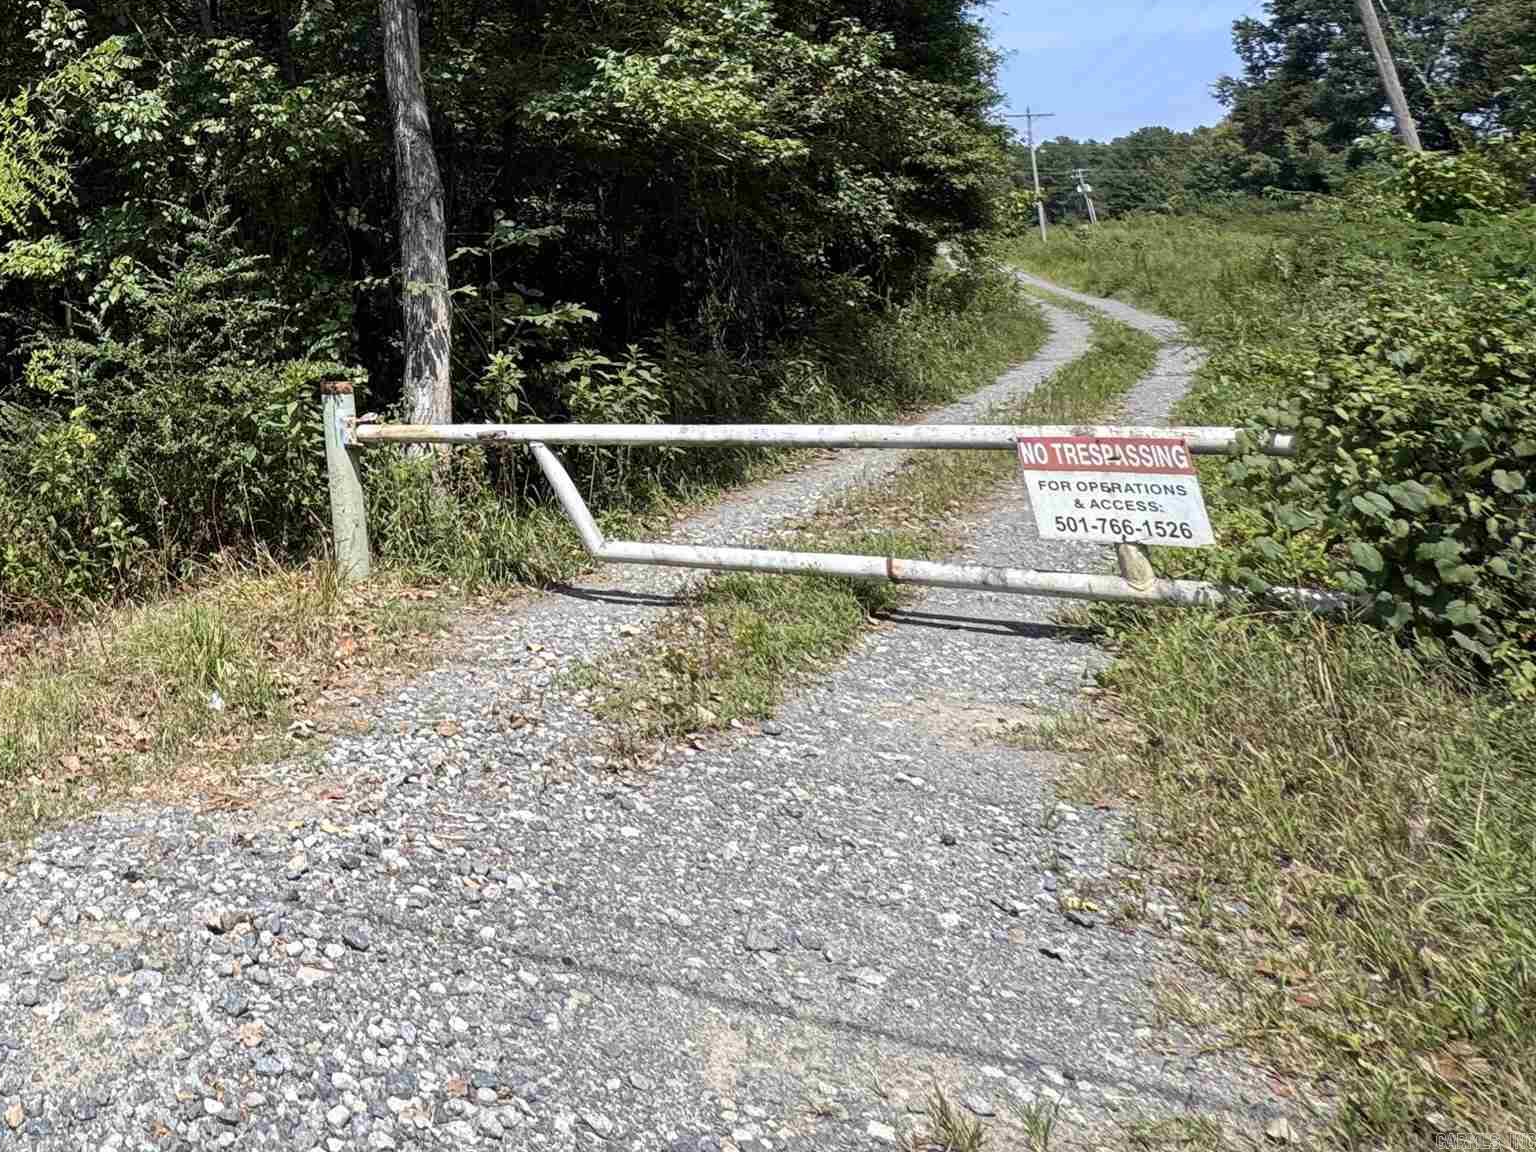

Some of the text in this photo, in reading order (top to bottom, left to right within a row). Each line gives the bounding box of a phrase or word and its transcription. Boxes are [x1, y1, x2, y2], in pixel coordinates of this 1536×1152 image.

[1019, 441, 1190, 469] NO TRESPASSING
[1038, 480, 1188, 496] FOR OPERATIONS
[1074, 499, 1165, 512] & ACCESS:
[1055, 516, 1193, 539] 501-766-1526
